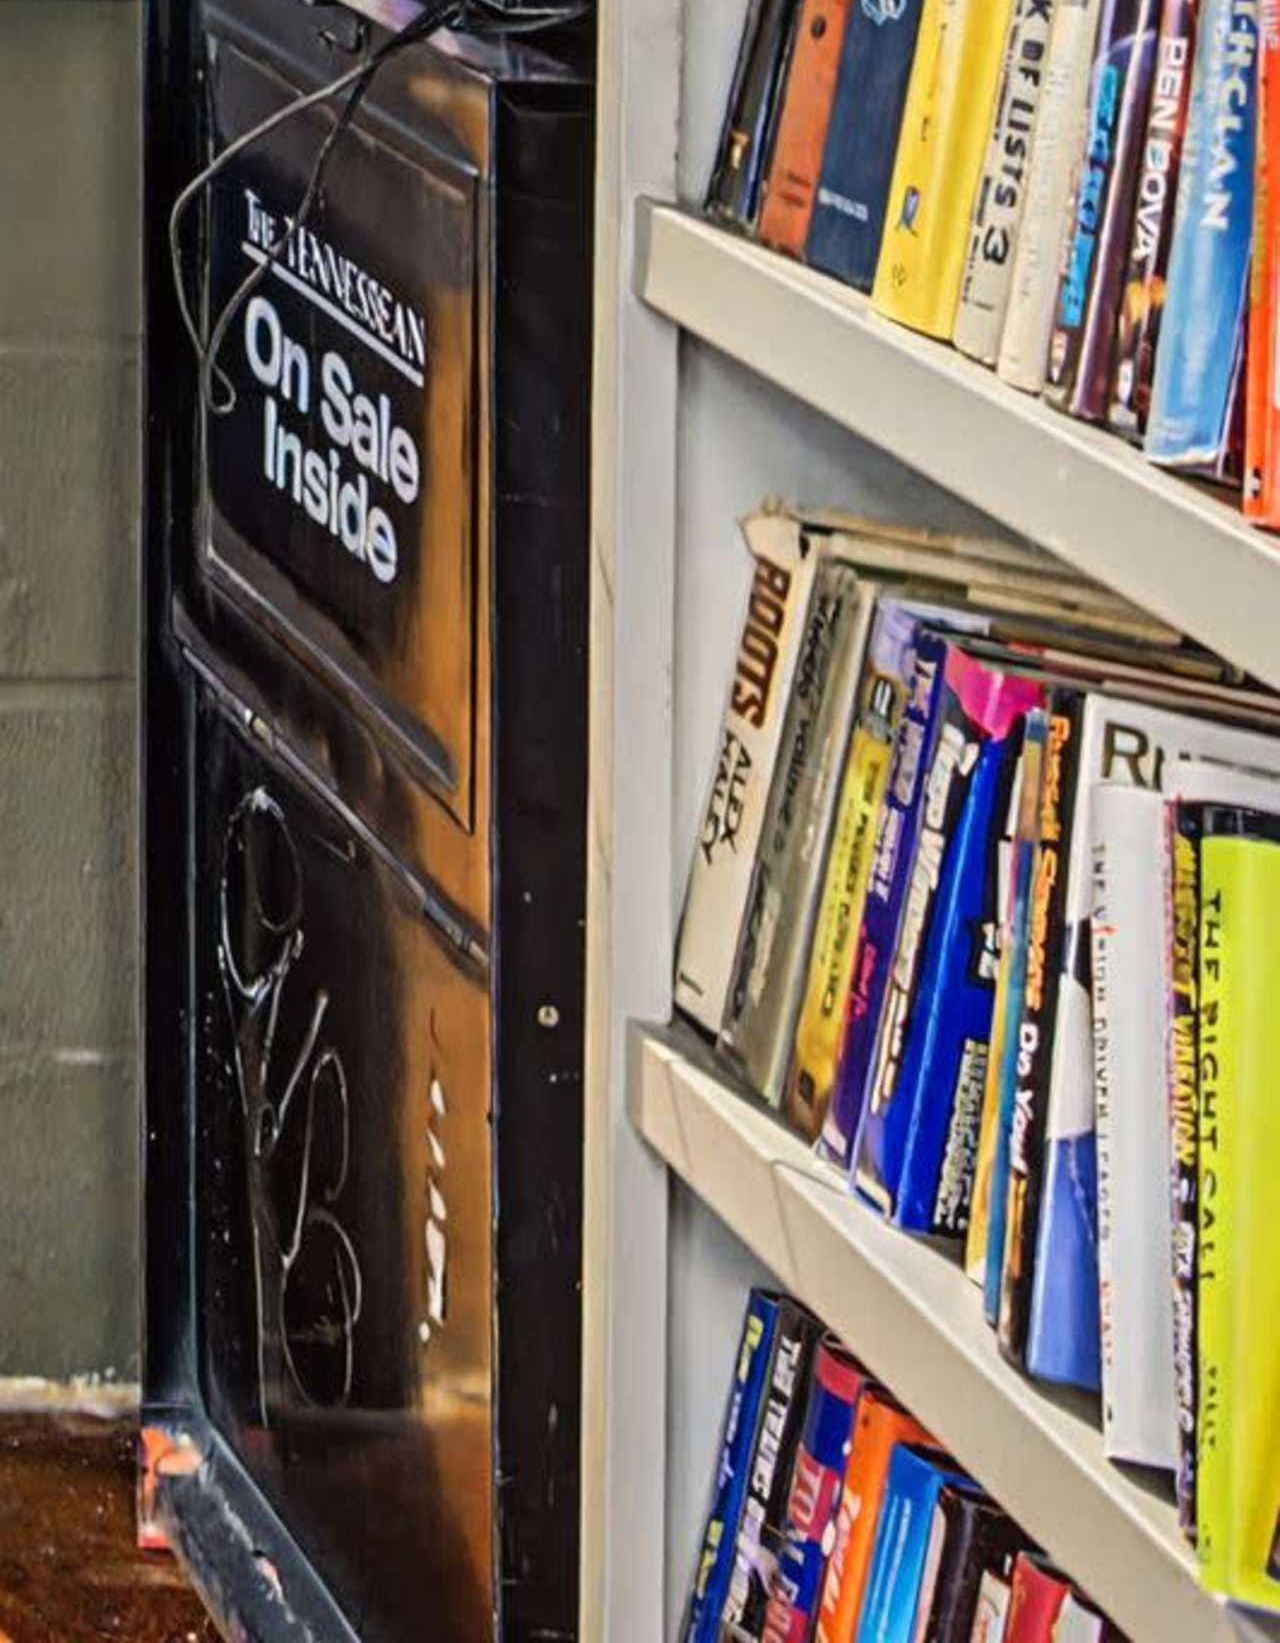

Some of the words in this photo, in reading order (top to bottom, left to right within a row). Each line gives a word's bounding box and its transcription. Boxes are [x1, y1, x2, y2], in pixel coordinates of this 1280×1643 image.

[1015, 38, 1045, 87] OF
[1152, 36, 1192, 139] BEN
[993, 97, 1034, 209] LISTS
[1132, 143, 1181, 262] BOVA
[283, 213, 426, 368] TENNESSEAN
[981, 223, 1012, 269] 3
[244, 295, 309, 414] On
[320, 350, 420, 504] Sale
[263, 395, 397, 584] Inside
[731, 557, 792, 728] ROOTS
[696, 727, 737, 864] HALEY
[717, 743, 754, 854] ALEX
[1204, 890, 1221, 982] THE
[1015, 1019, 1039, 1081] Do
[1200, 1000, 1218, 1151] RIGHT
